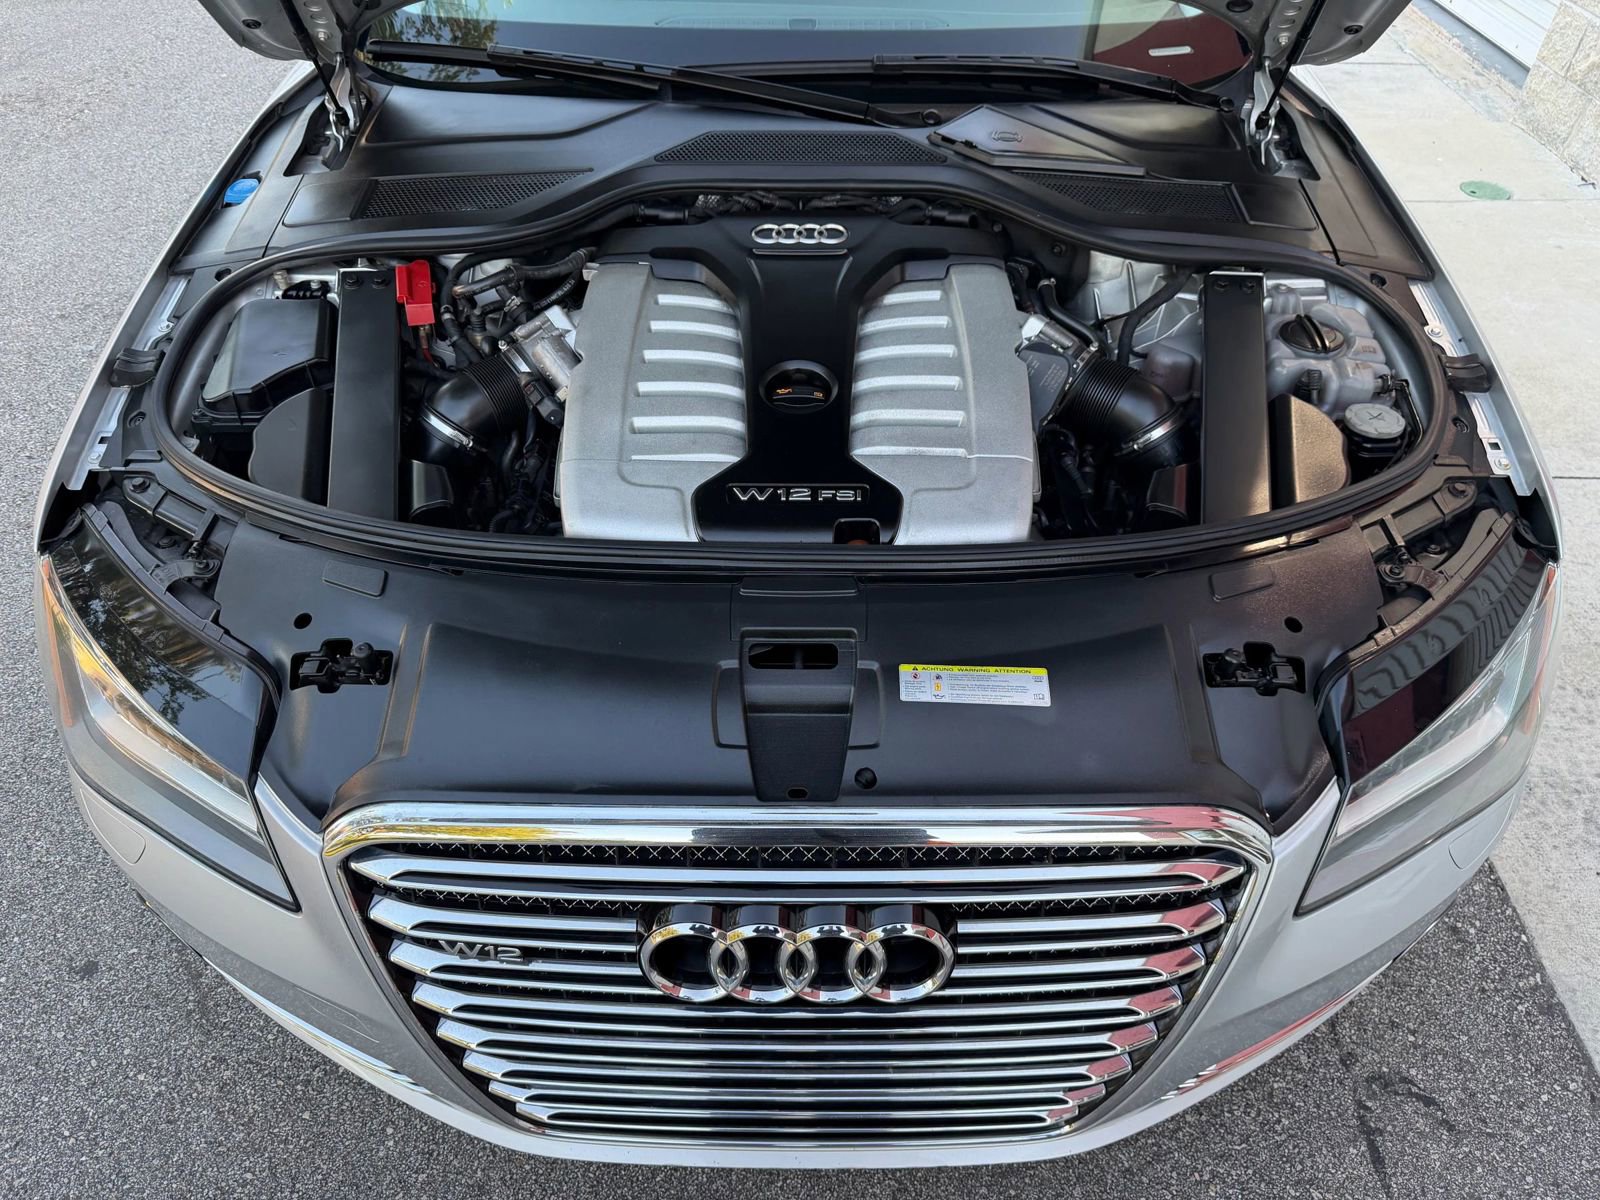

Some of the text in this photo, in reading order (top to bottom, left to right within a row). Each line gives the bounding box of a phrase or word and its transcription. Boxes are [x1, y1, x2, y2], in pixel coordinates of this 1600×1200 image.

[732, 488, 862, 501] W12 FSI
[438, 940, 524, 962] W12
